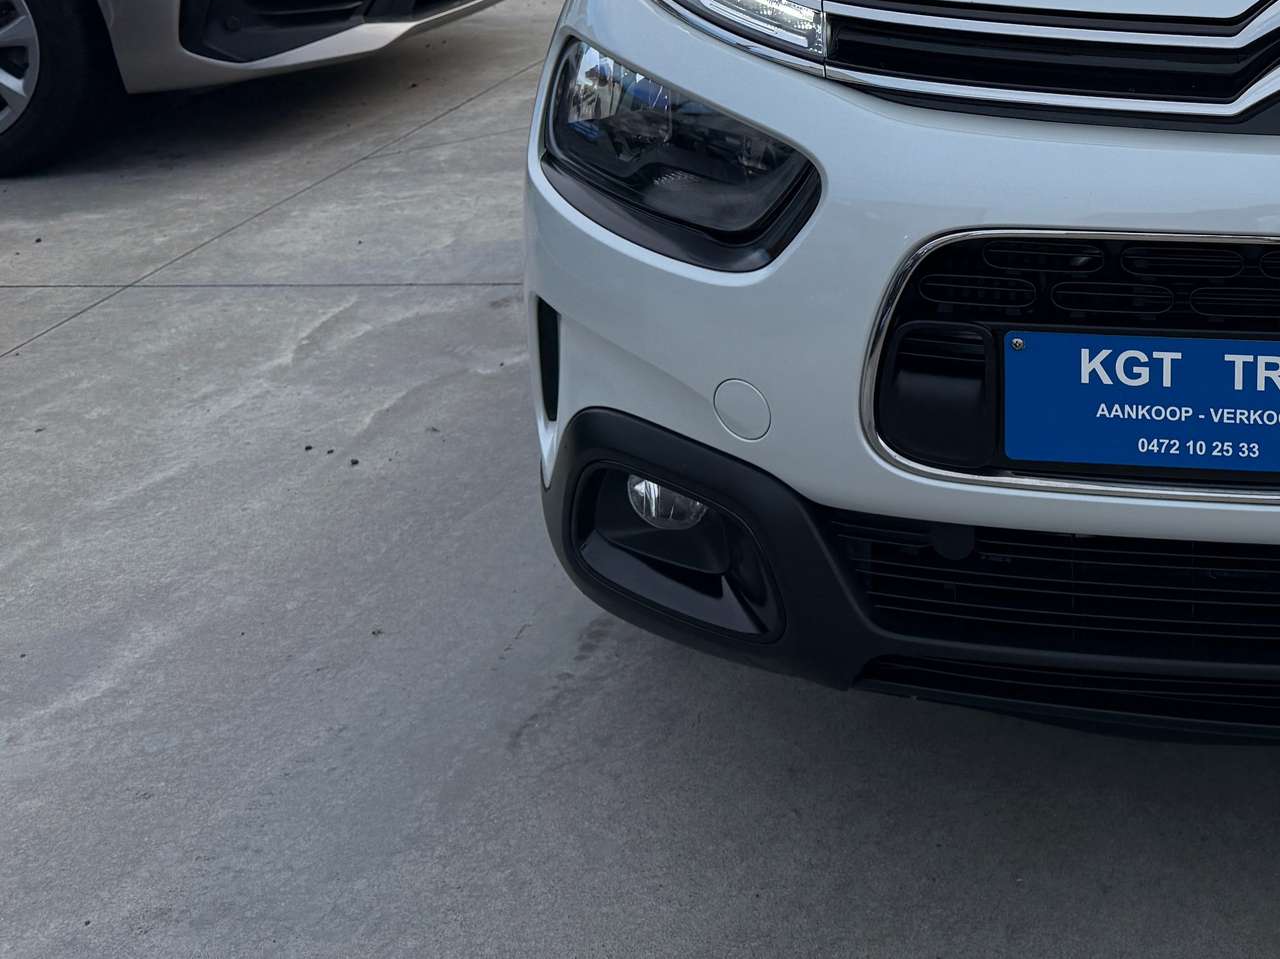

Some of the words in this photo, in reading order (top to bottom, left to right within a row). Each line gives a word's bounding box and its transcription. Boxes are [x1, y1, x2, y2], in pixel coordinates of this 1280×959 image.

[1080, 348, 1182, 388] KGT
[1096, 403, 1193, 422] AANKOOP
[1137, 438, 1180, 454] 0472
[1186, 440, 1206, 456] 10
[1211, 441, 1233, 457] 25
[1238, 442, 1260, 458] 33
